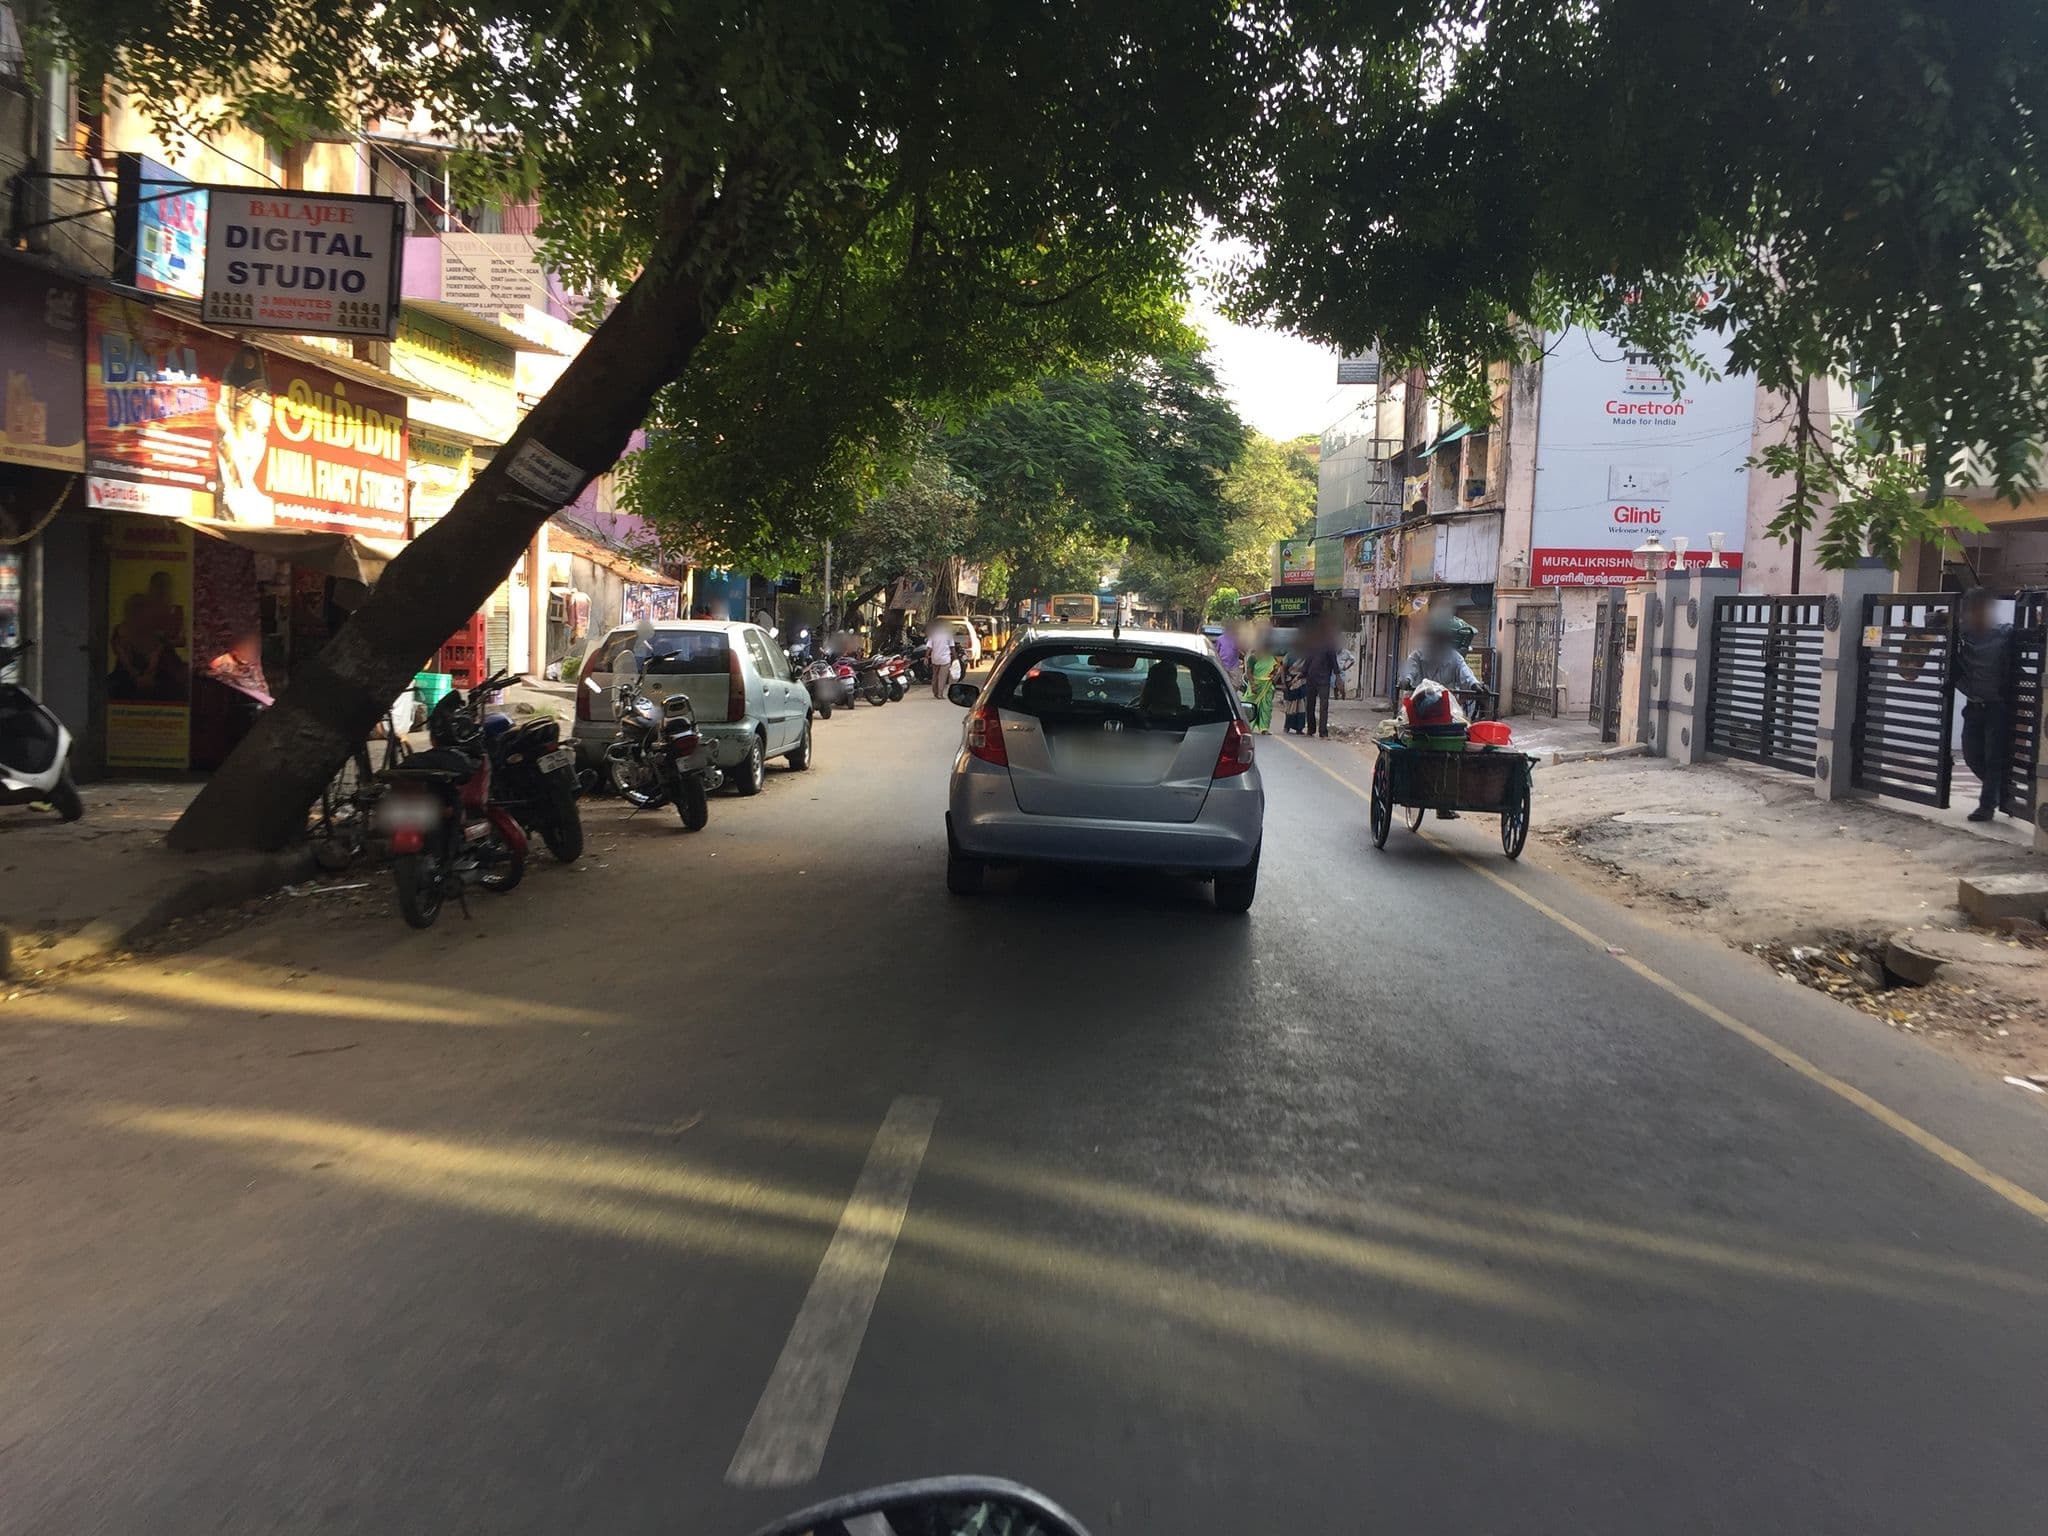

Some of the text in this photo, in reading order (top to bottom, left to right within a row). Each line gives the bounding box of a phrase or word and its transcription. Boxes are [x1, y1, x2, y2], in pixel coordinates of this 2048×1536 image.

[249, 200, 355, 226] BALAJEE
[226, 225, 373, 258] DIGITAL
[227, 261, 366, 293] STUDIO
[272, 297, 333, 309] MINUTES
[259, 308, 334, 322] PASS PORT
[1606, 400, 1684, 415] Caretron
[1639, 417, 1652, 425] for
[1654, 418, 1676, 426] India
[315, 459, 360, 505] FANCY
[1614, 506, 1661, 523] Glint
[1608, 526, 1666, 536] Welcome Change
